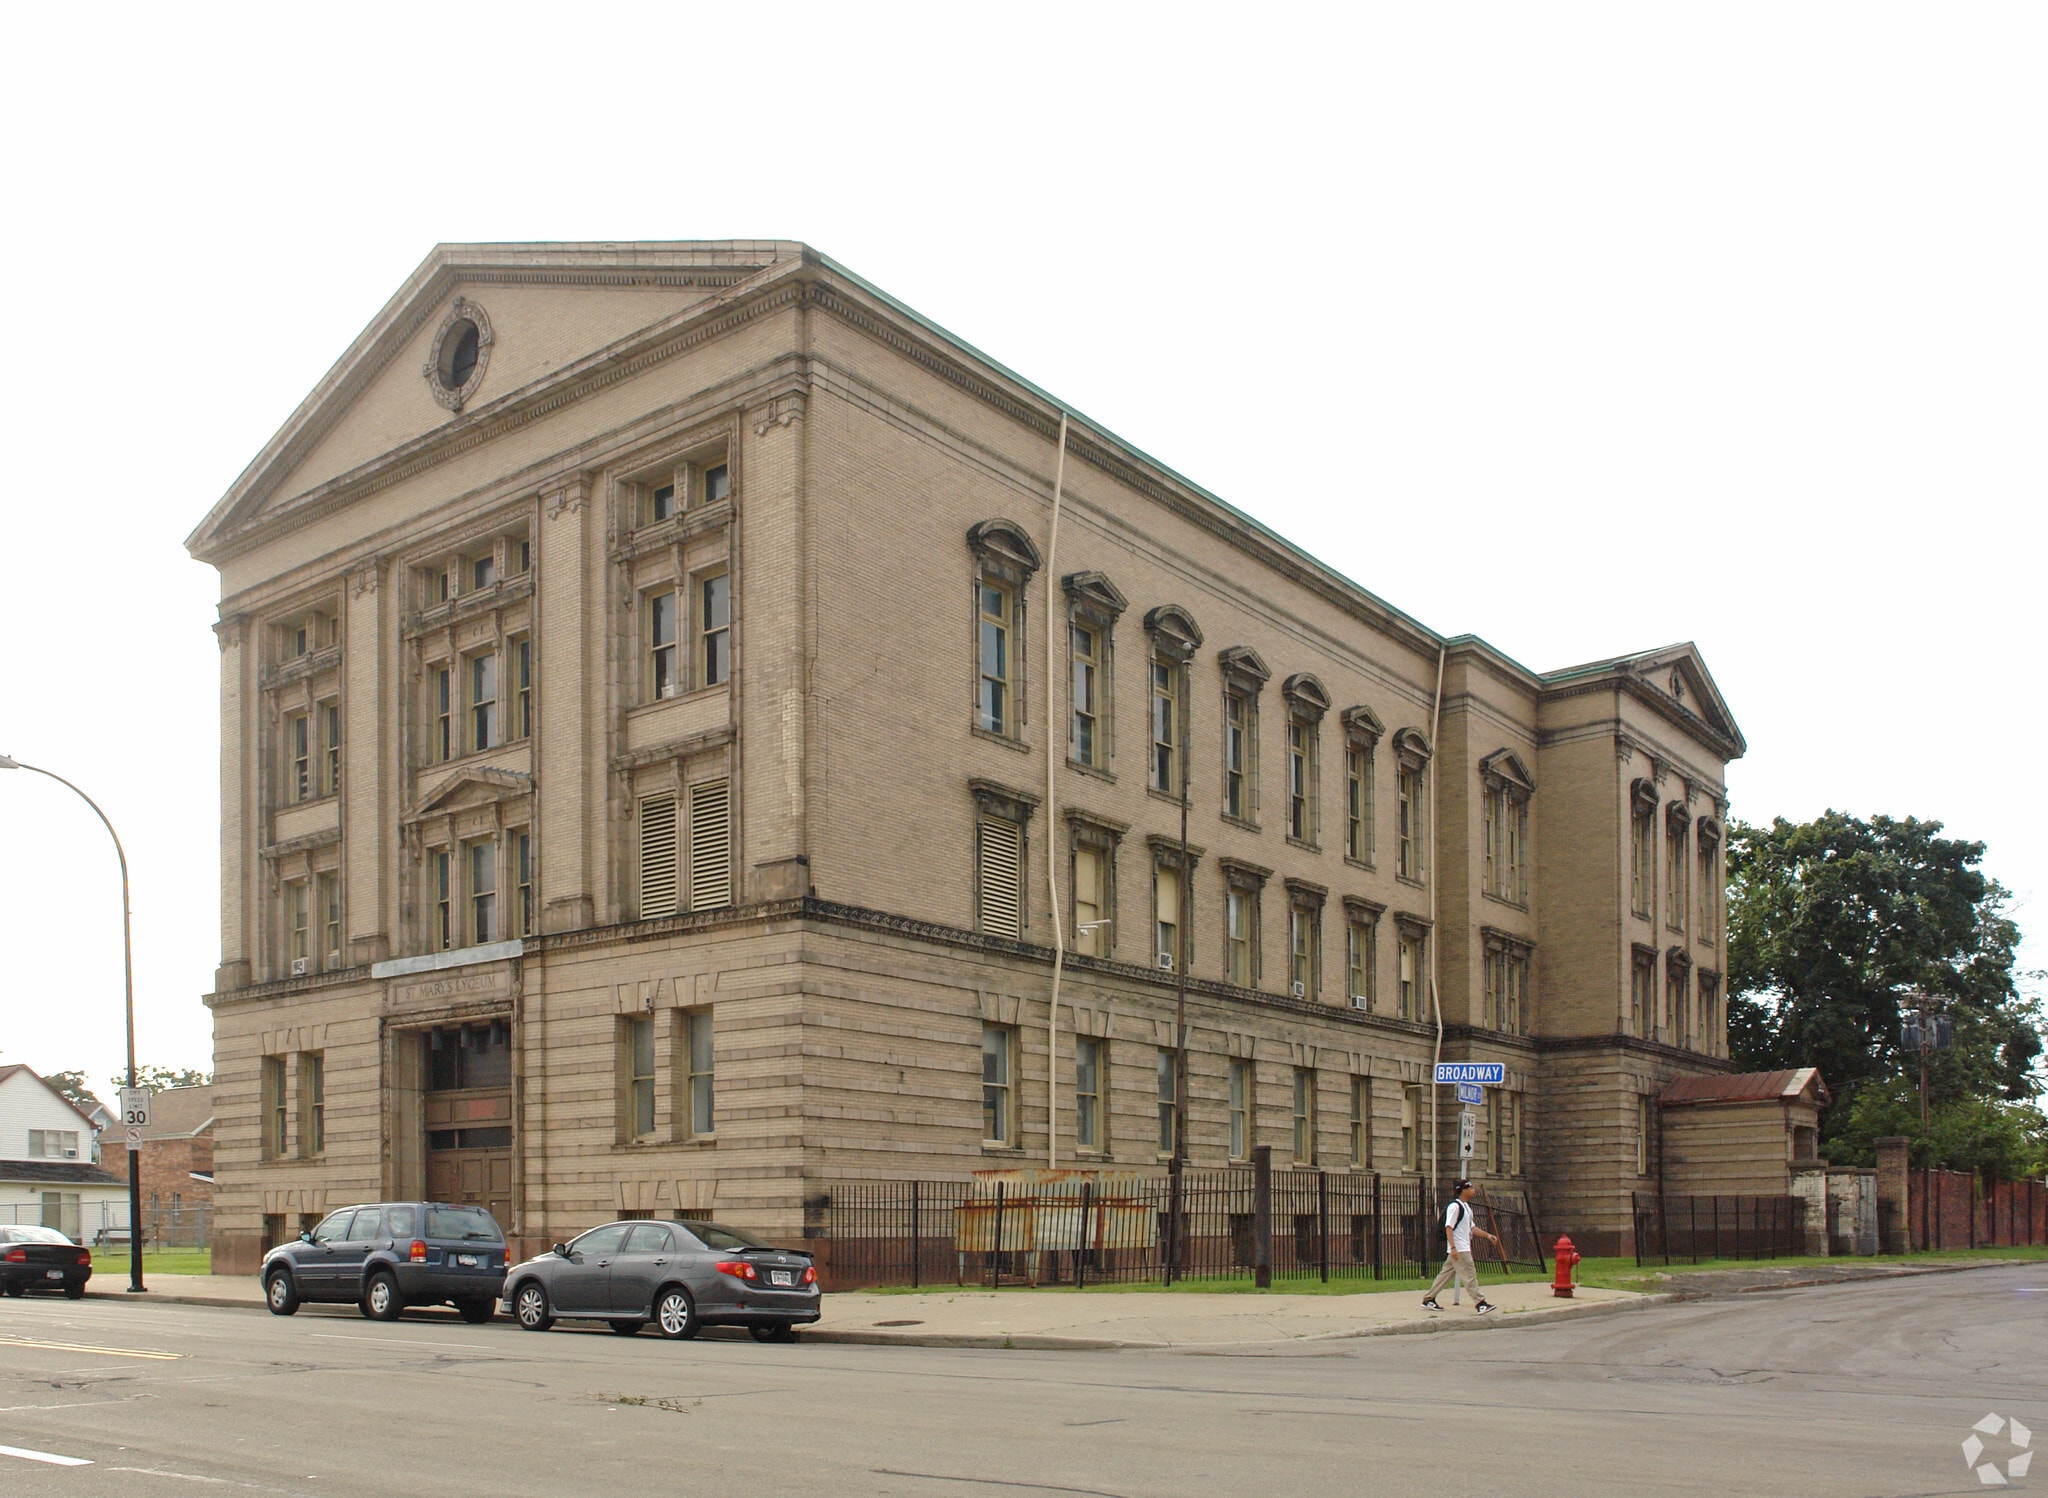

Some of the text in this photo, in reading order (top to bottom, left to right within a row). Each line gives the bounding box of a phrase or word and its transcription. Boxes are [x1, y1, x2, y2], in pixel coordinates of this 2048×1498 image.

[456, 975, 496, 992] LYCEUM
[1438, 1066, 1500, 1080] BROADWAY
[126, 1111, 146, 1124] 30
[1464, 1115, 1474, 1127] ONE
[1463, 1128, 1474, 1139] WAY
